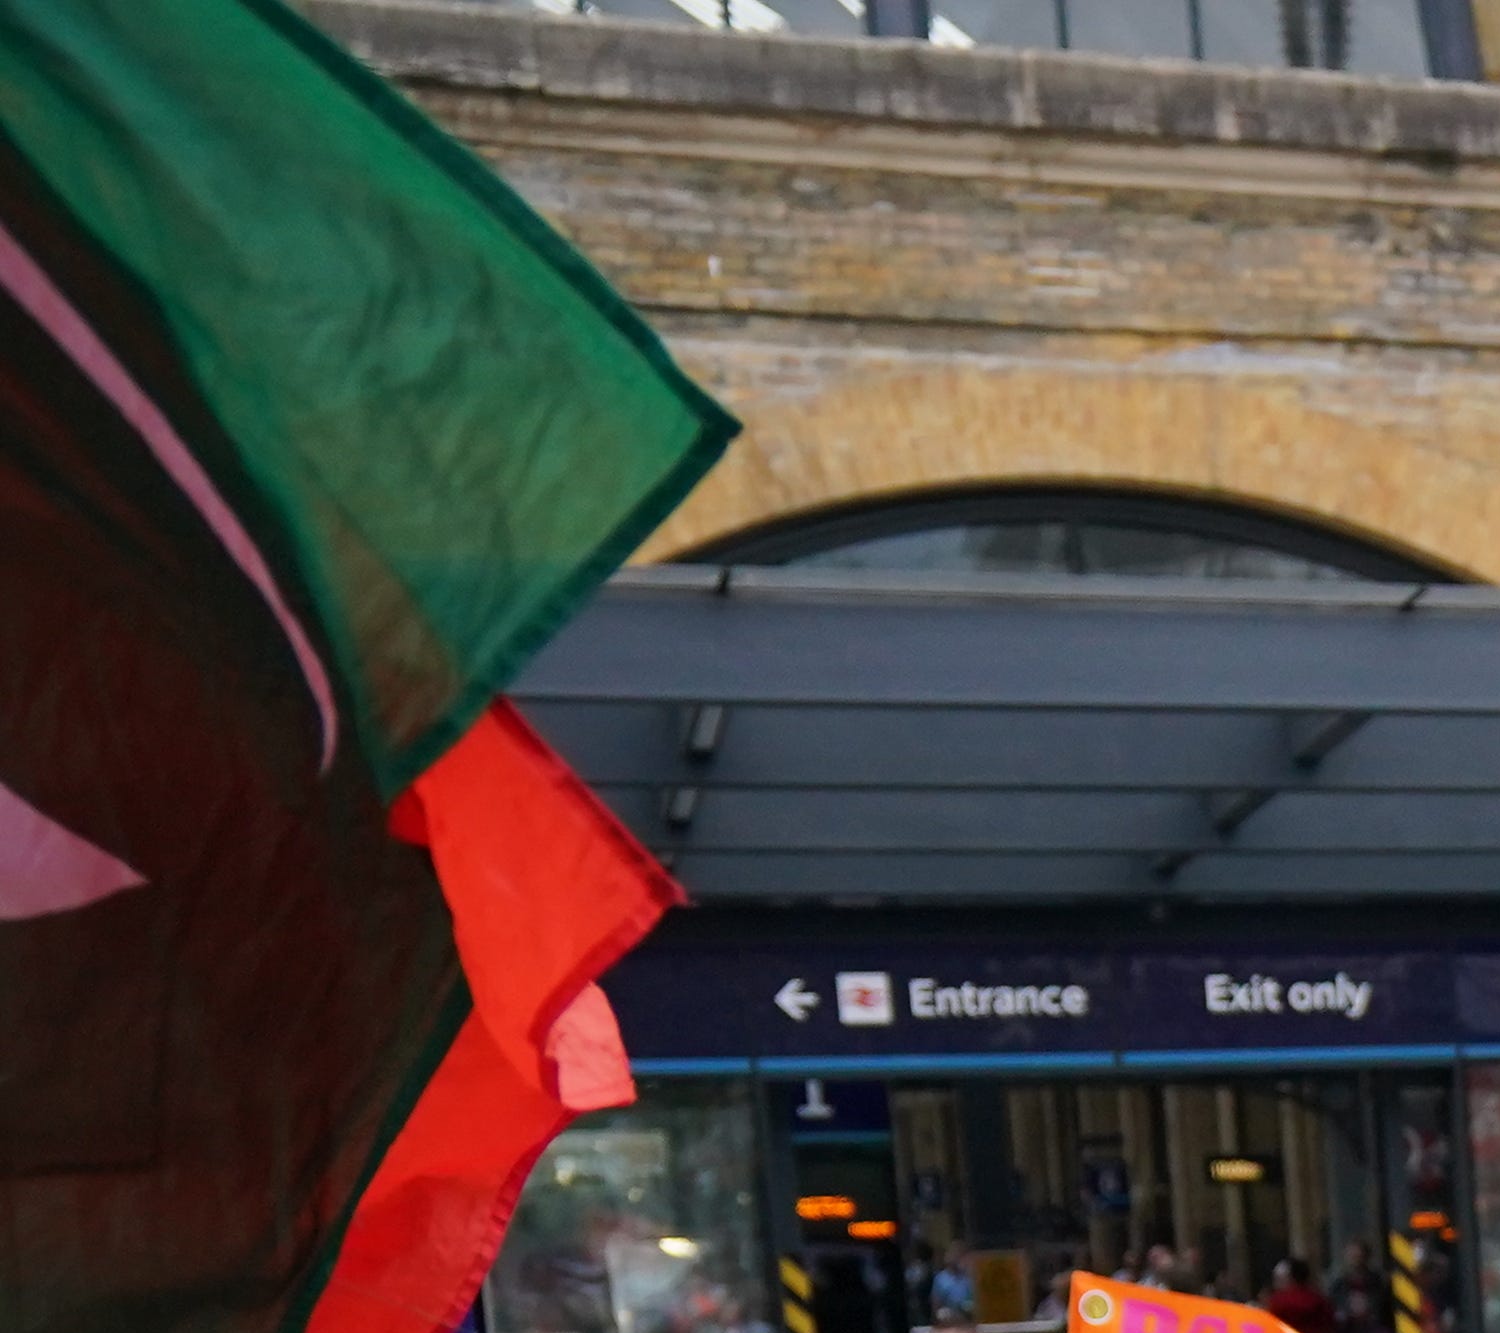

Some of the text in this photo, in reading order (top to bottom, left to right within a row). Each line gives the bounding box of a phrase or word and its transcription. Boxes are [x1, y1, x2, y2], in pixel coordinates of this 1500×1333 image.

[909, 977, 1090, 1017] Entrance
[1205, 973, 1371, 1019] Exit only
